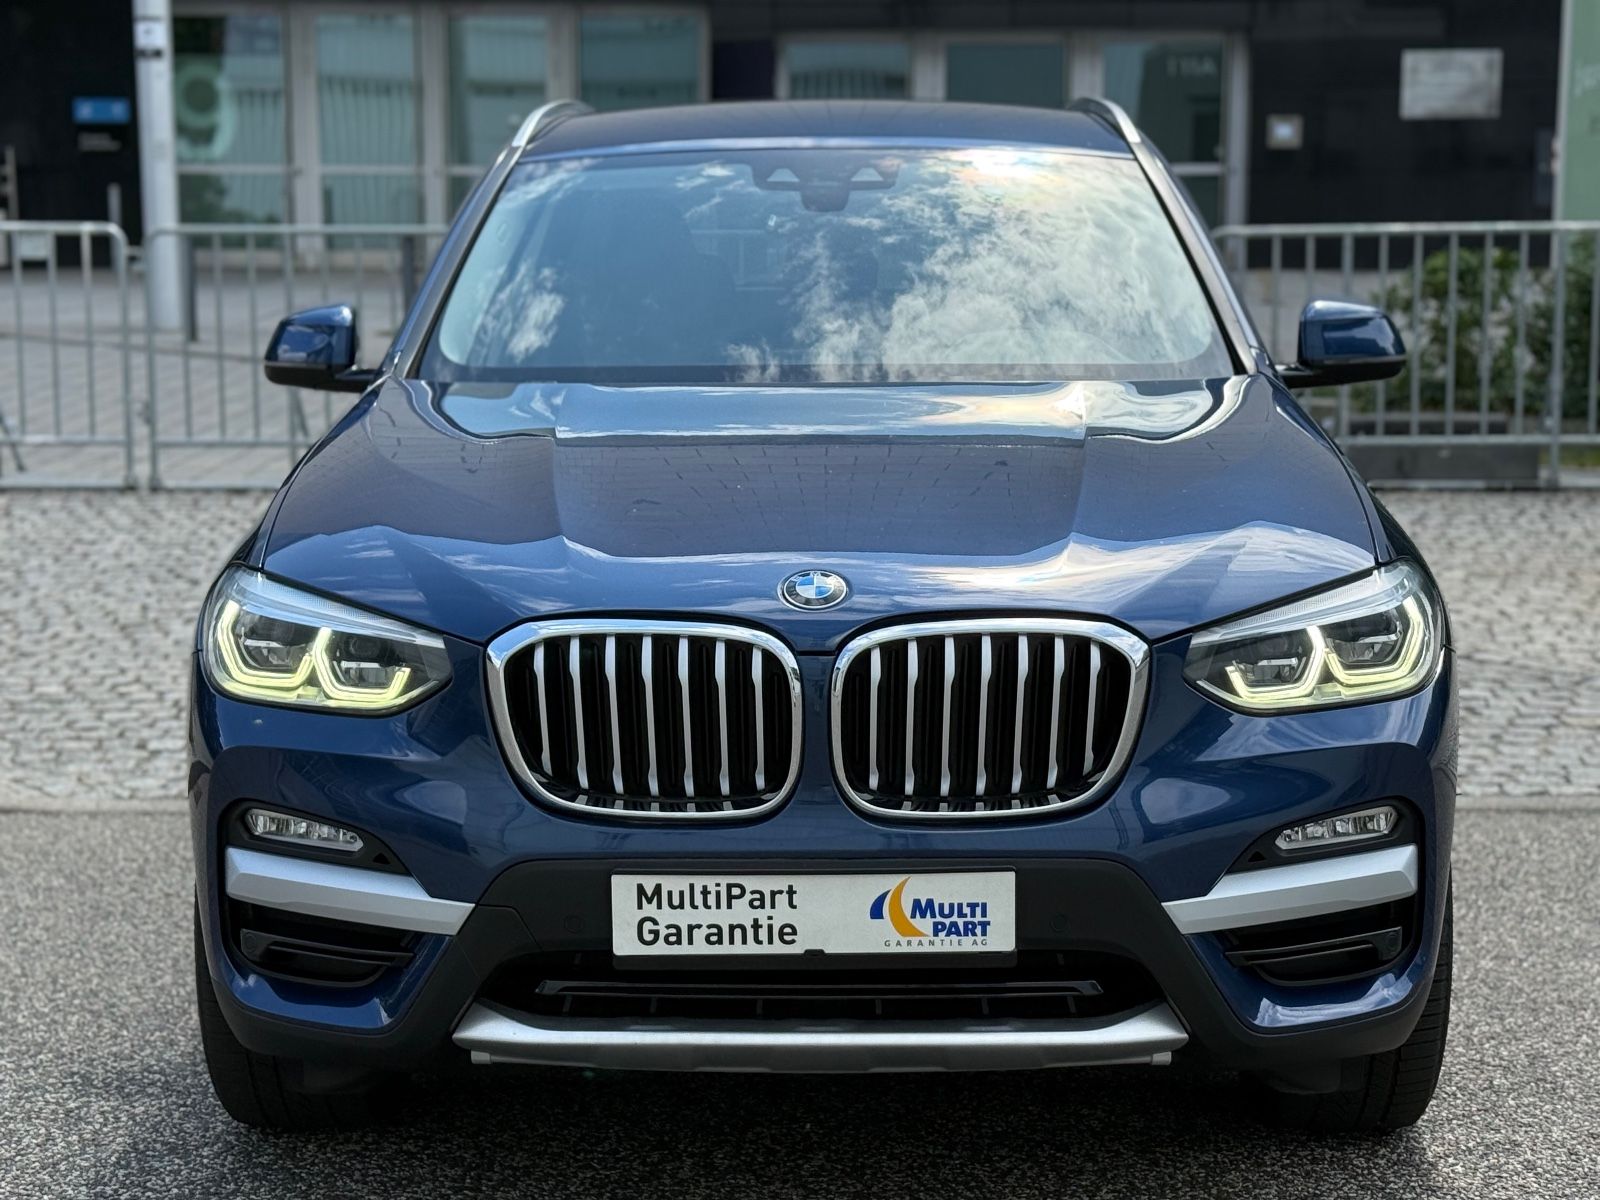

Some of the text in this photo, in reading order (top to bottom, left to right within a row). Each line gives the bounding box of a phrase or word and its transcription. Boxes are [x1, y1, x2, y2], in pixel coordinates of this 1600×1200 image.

[636, 882, 798, 910] MultiPart
[910, 898, 988, 919] MULTI
[636, 915, 798, 946] Garantie
[932, 920, 991, 937] PART
[884, 938, 988, 947] GARANTIE AG
